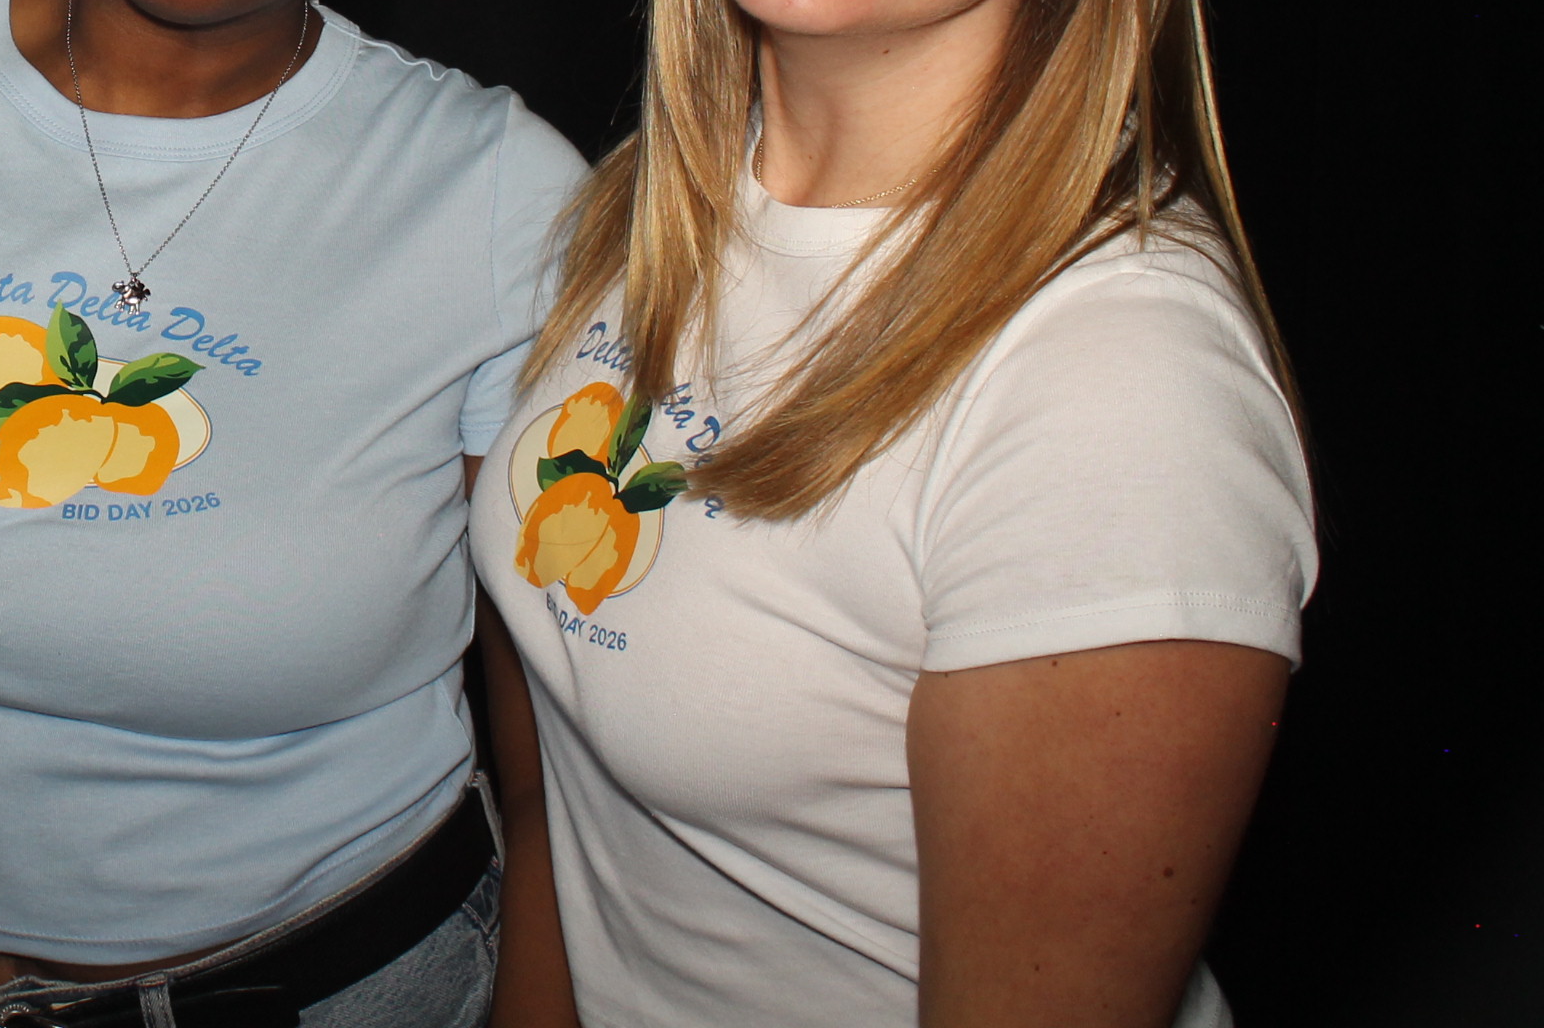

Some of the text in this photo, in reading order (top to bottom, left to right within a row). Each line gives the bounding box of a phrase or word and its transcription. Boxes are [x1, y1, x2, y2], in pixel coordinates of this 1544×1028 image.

[47, 271, 151, 332] Delta
[160, 306, 262, 377] Delta
[660, 382, 695, 429] lta
[62, 492, 221, 521] BID DAY 2026
[559, 610, 627, 651] DAY 2026
